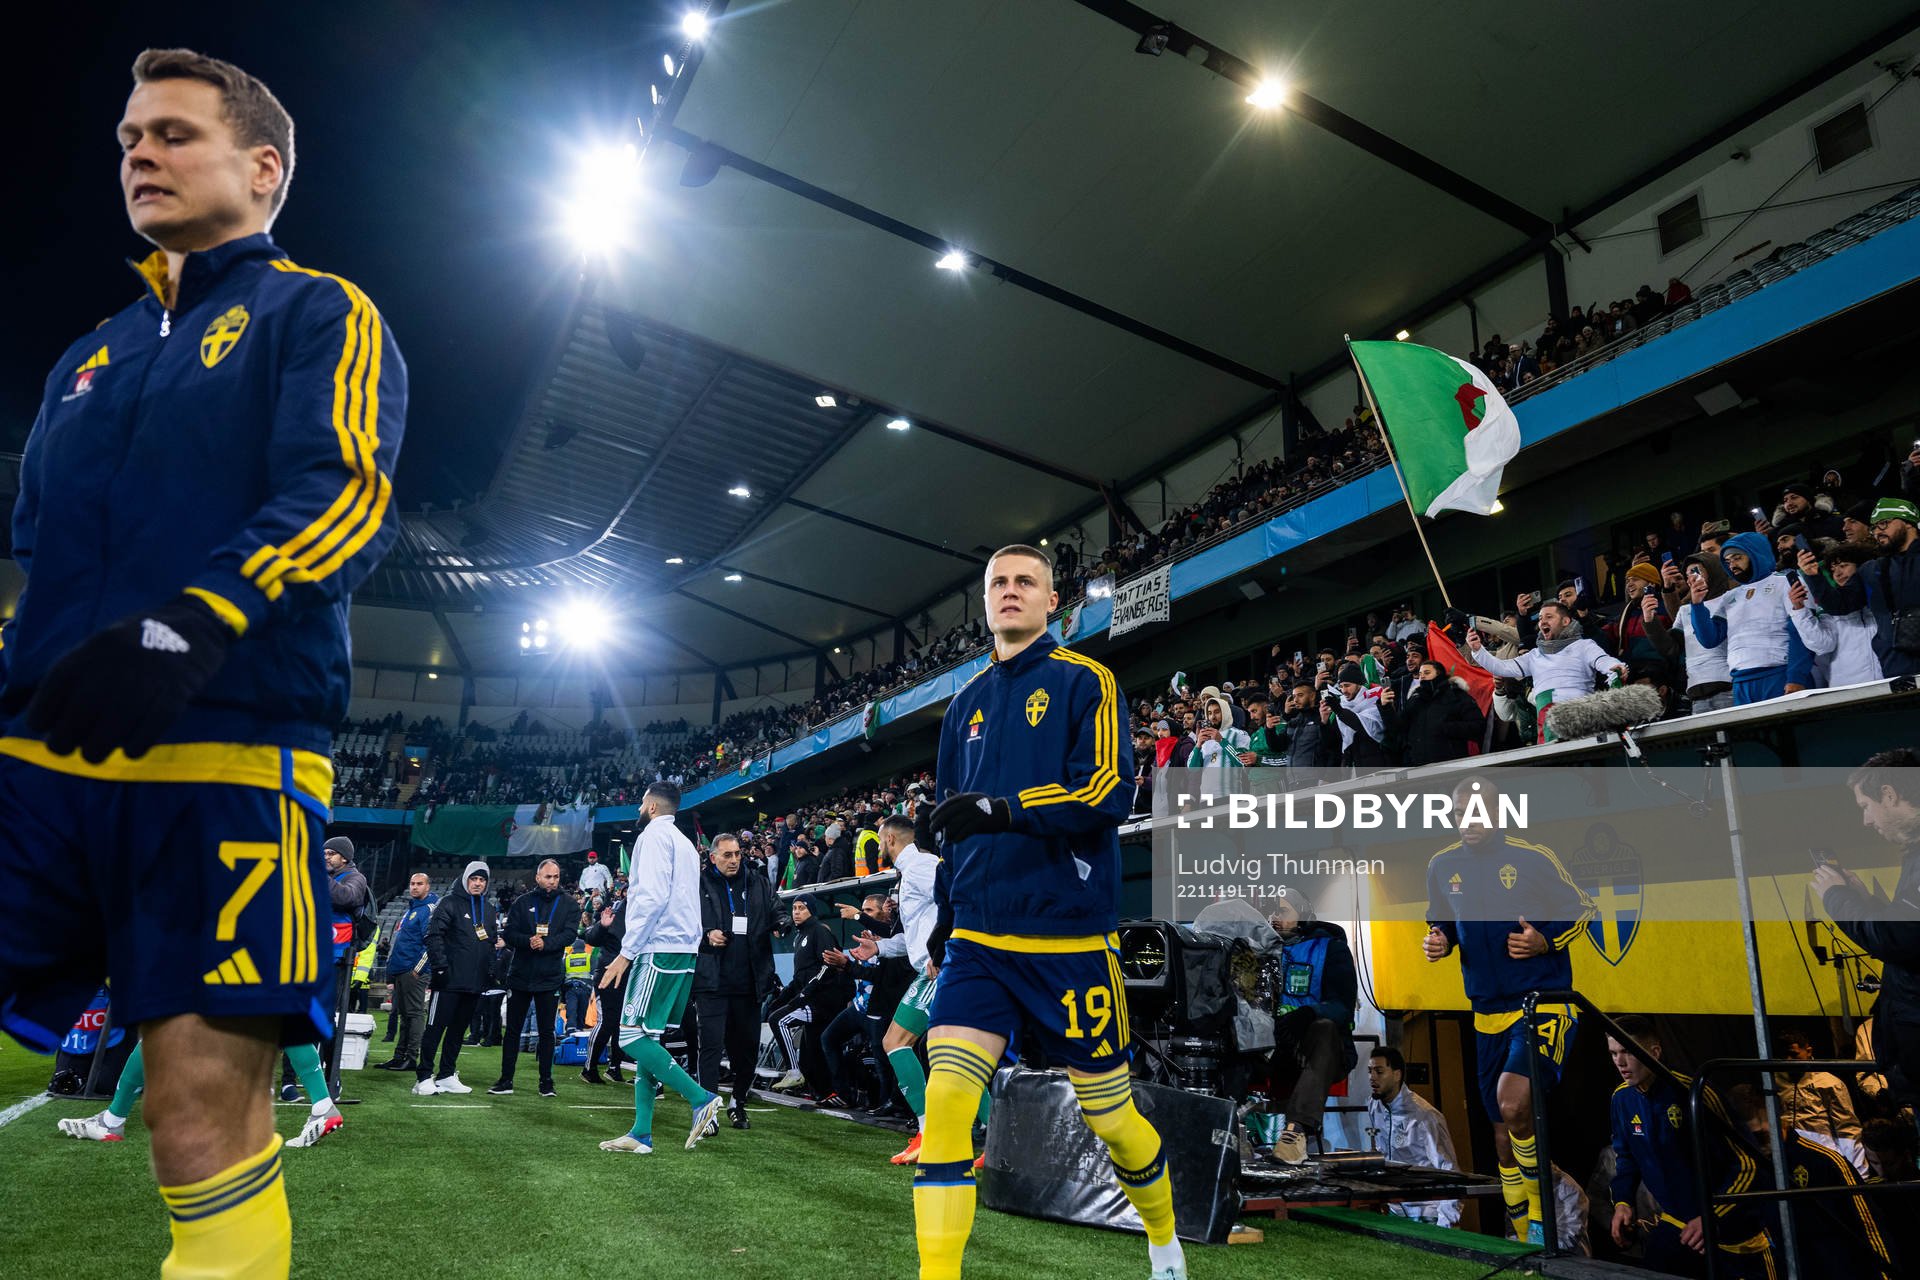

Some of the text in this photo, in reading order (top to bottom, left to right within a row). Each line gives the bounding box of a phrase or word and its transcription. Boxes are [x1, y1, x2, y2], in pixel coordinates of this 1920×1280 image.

[1115, 576, 1162, 608] MATTIAS
[1112, 593, 1165, 627] SVANBERG
[215, 840, 280, 942] 7
[1060, 985, 1112, 1039] 19
[1537, 1018, 1558, 1046] 4
